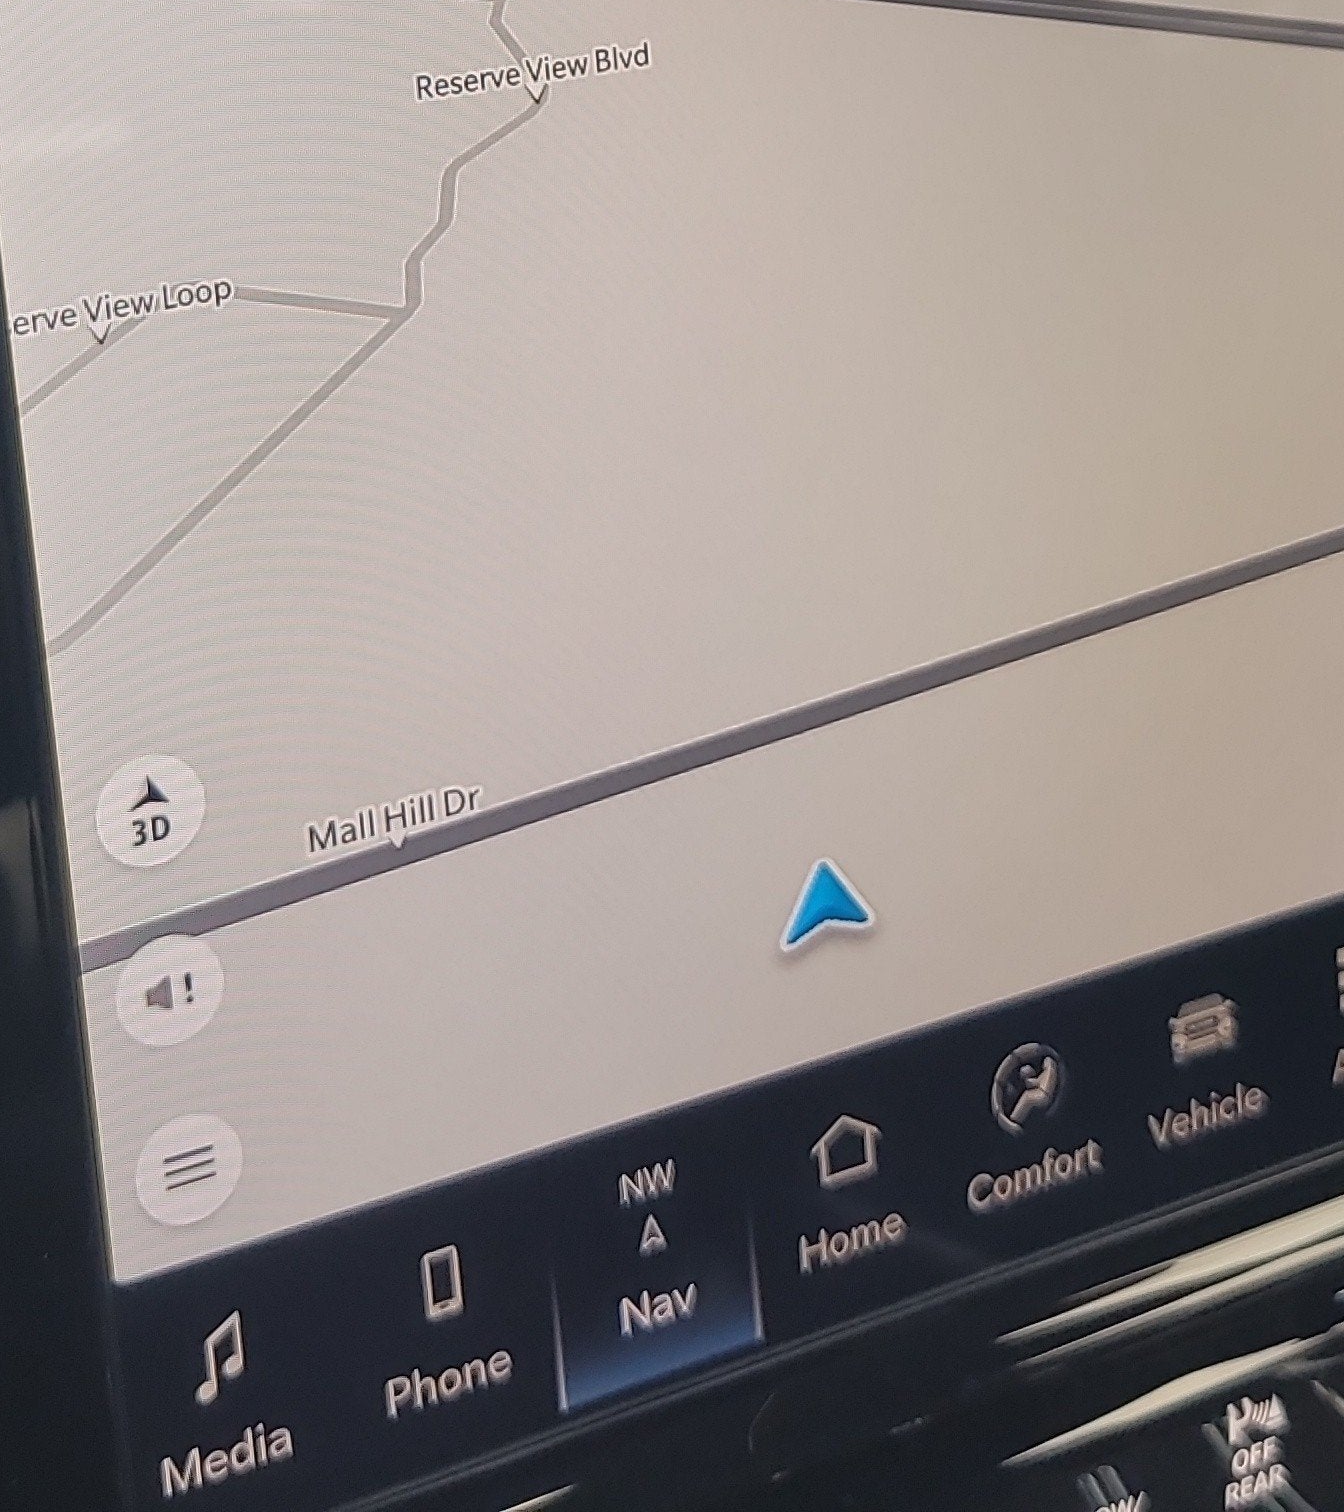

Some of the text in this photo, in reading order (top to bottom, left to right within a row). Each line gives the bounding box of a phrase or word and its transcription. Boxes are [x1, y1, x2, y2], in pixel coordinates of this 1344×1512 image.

[416, 42, 650, 101] Reserve View Blvd
[12, 279, 232, 336] erve View Loop
[131, 815, 171, 846] 3D
[309, 785, 480, 853] Mall Hill Dr
[1147, 1083, 1270, 1150] Vehicle
[618, 1157, 677, 1208] NW
[967, 1137, 1104, 1213] Comfort
[798, 1212, 910, 1274] Home
[618, 1282, 699, 1339] Nav
[383, 1349, 514, 1420] Phone
[160, 1422, 296, 1499] Media
[1224, 1463, 1291, 1509] REAR
[1230, 1437, 1284, 1478] OFF
